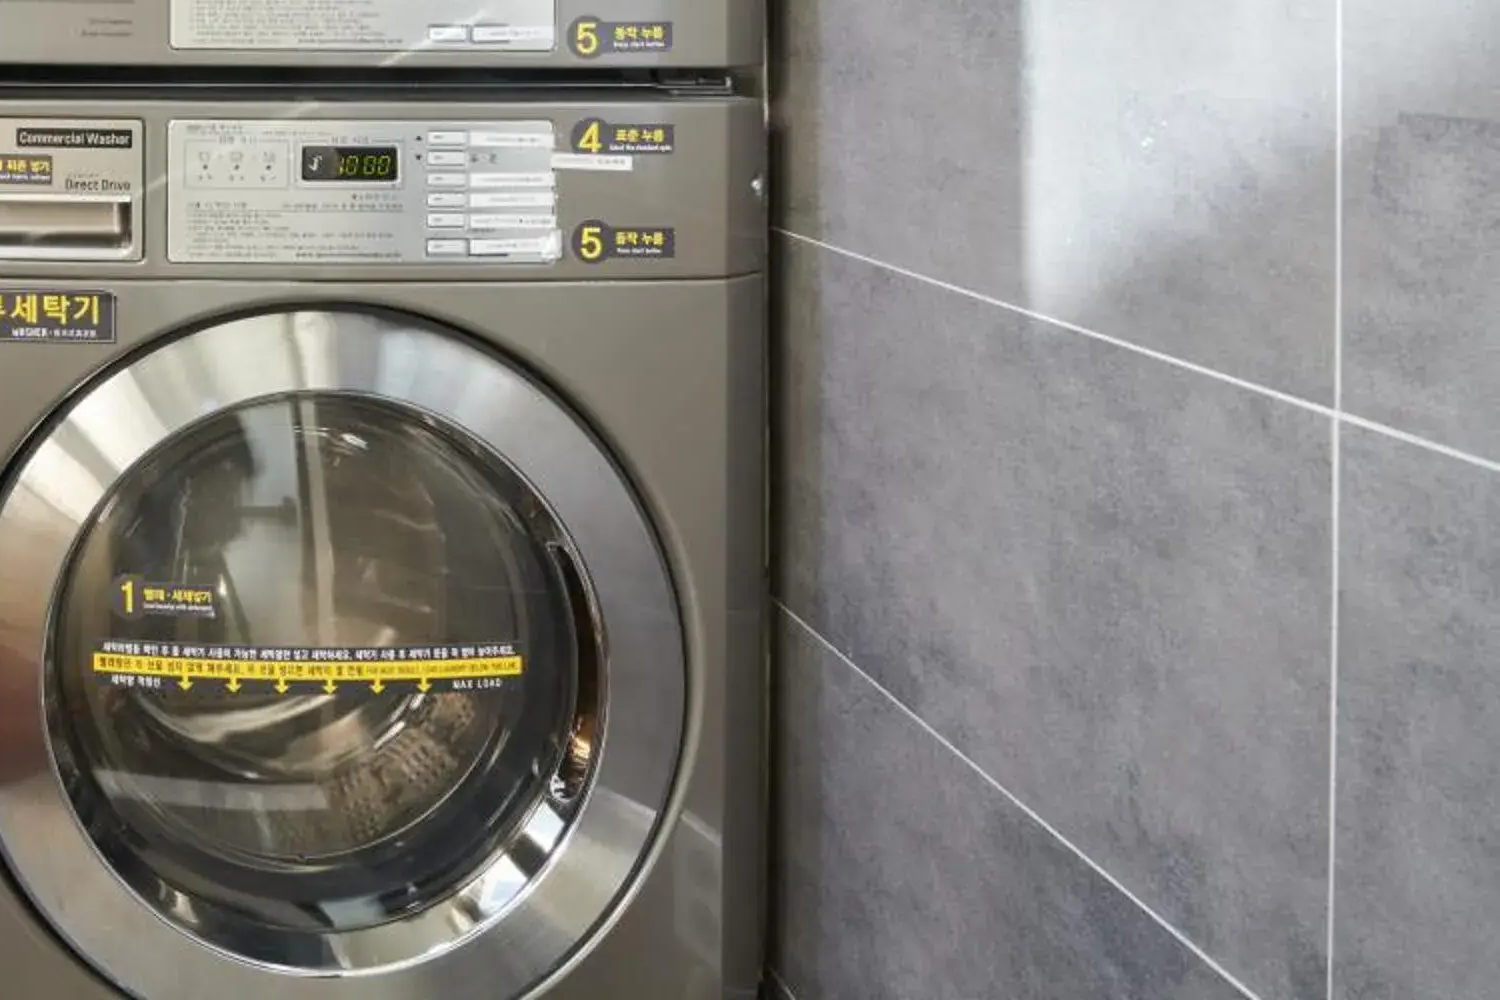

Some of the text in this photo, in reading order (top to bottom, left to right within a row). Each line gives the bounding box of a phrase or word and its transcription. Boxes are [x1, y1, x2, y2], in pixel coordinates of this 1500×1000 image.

[577, 22, 598, 55] 5
[19, 132, 130, 145] Commercial Washer
[578, 121, 602, 153] 4
[65, 179, 131, 191] Direct Drive
[580, 227, 602, 259] 5
[120, 581, 134, 613] 1
[452, 677, 503, 689] MAX LOAD
